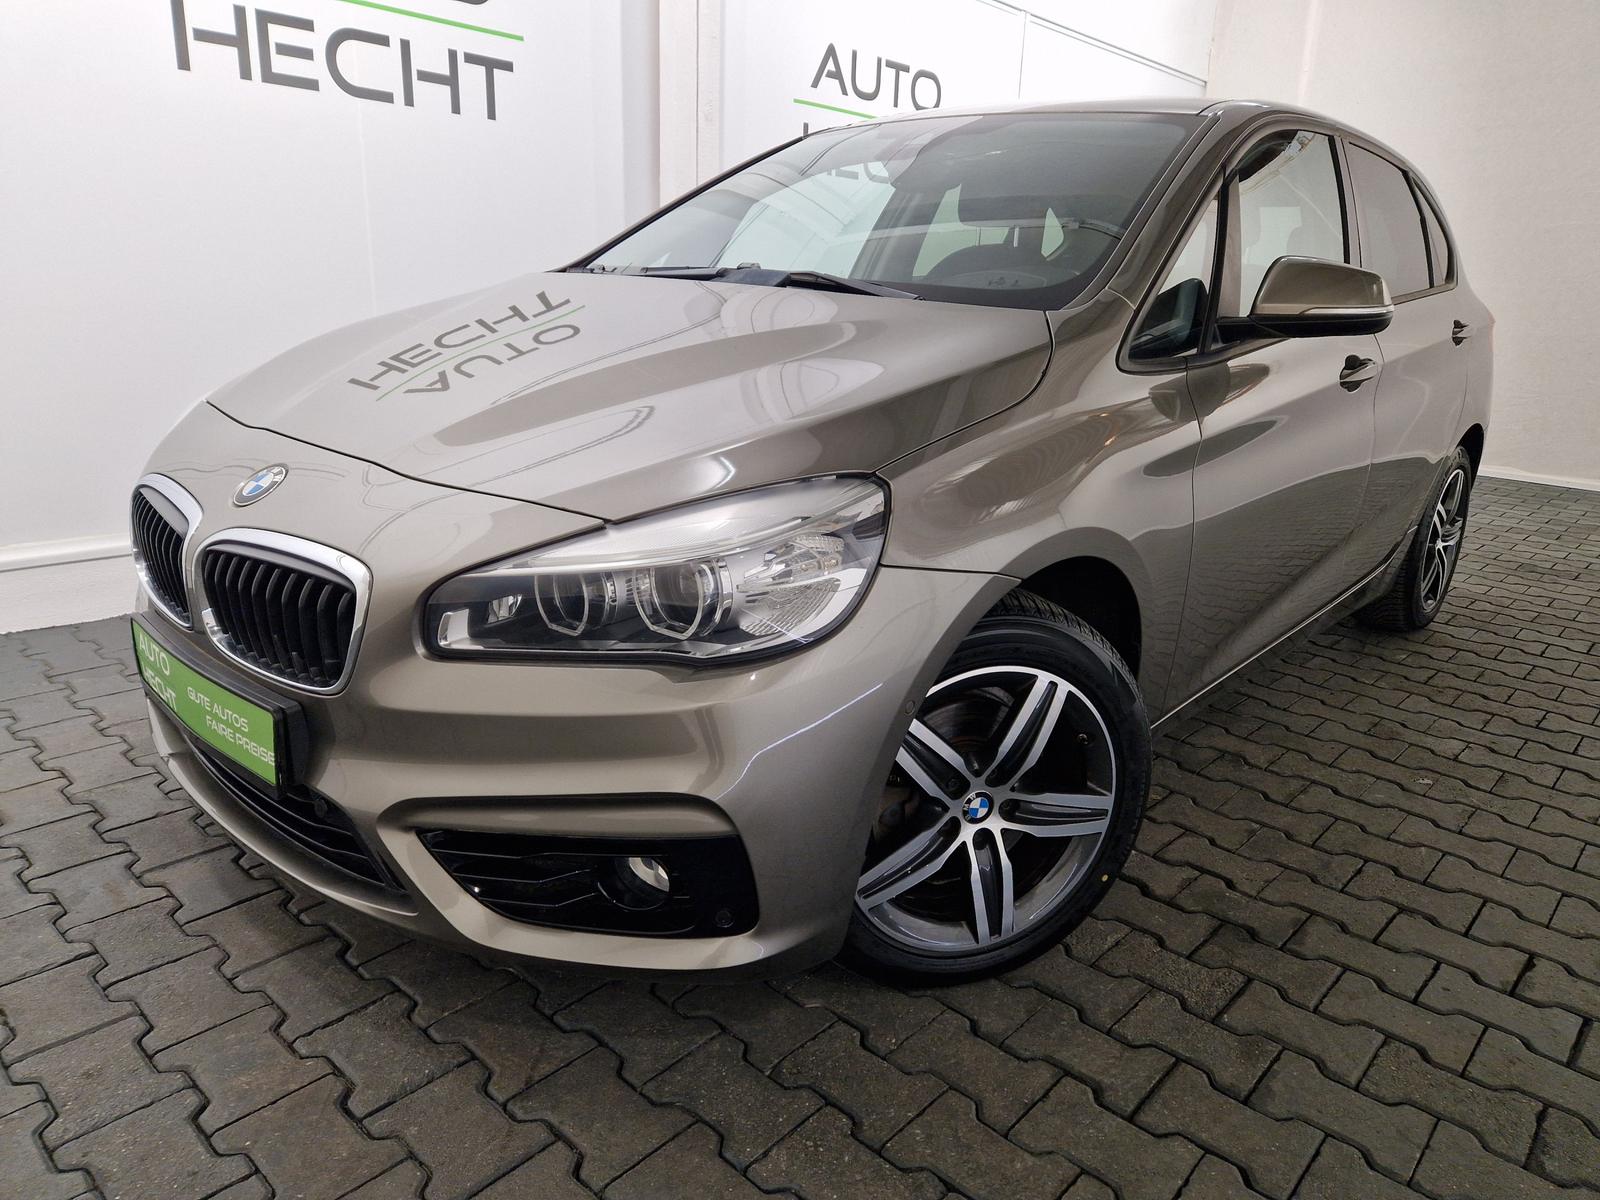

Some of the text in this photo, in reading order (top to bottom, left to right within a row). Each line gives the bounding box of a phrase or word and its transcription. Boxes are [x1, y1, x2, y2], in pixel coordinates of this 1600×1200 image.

[170, 0, 514, 121] HECHT
[810, 42, 942, 111] AUTO
[139, 633, 170, 676] AUTO
[142, 663, 177, 711] HECHT
[187, 687, 249, 732] GUTE AUTOS
[206, 715, 275, 766] FAIRE PREISE
